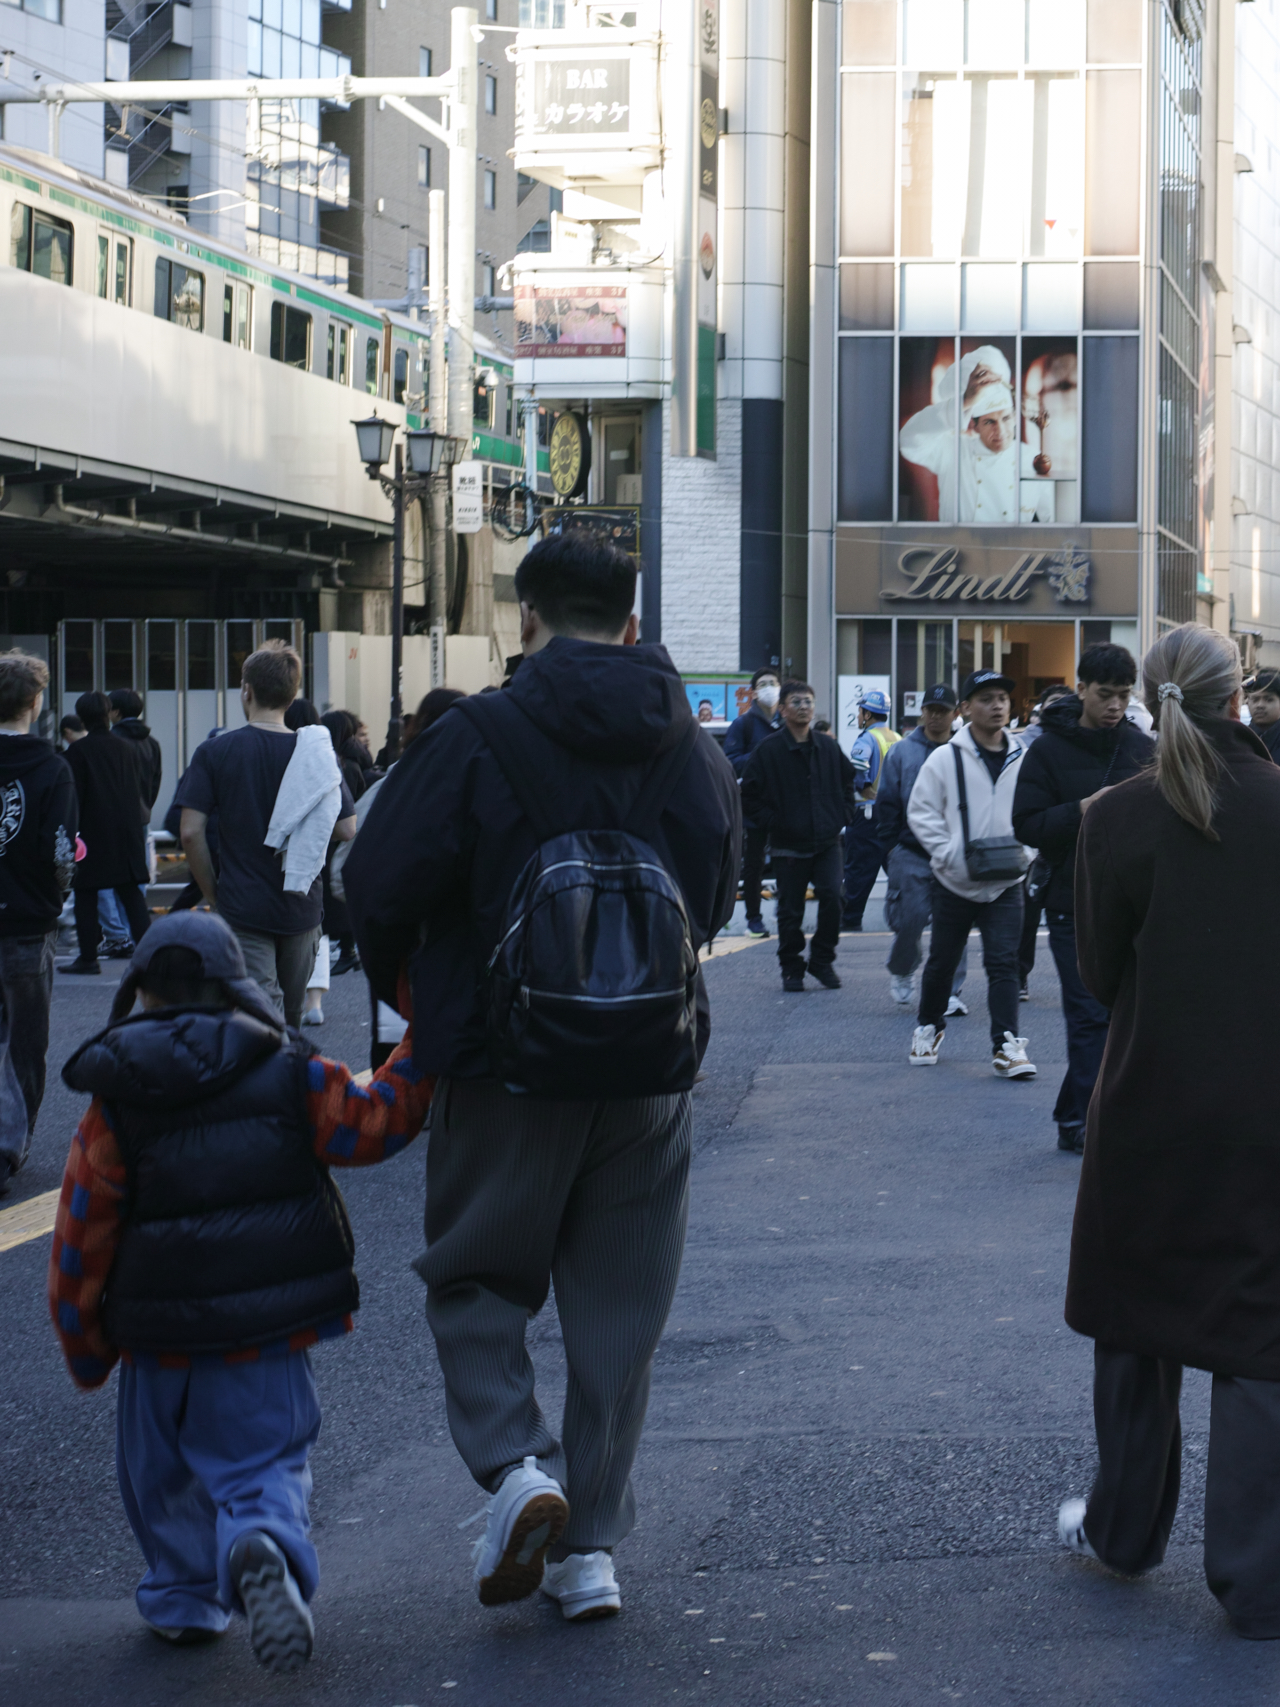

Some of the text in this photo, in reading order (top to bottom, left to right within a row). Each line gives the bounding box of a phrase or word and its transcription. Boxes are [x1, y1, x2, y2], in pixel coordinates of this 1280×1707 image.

[566, 68, 608, 89] BAR
[544, 101, 629, 124] カラオケ
[879, 546, 1048, 600] Lindt
[855, 684, 864, 698] 3
[847, 713, 856, 727] 2
